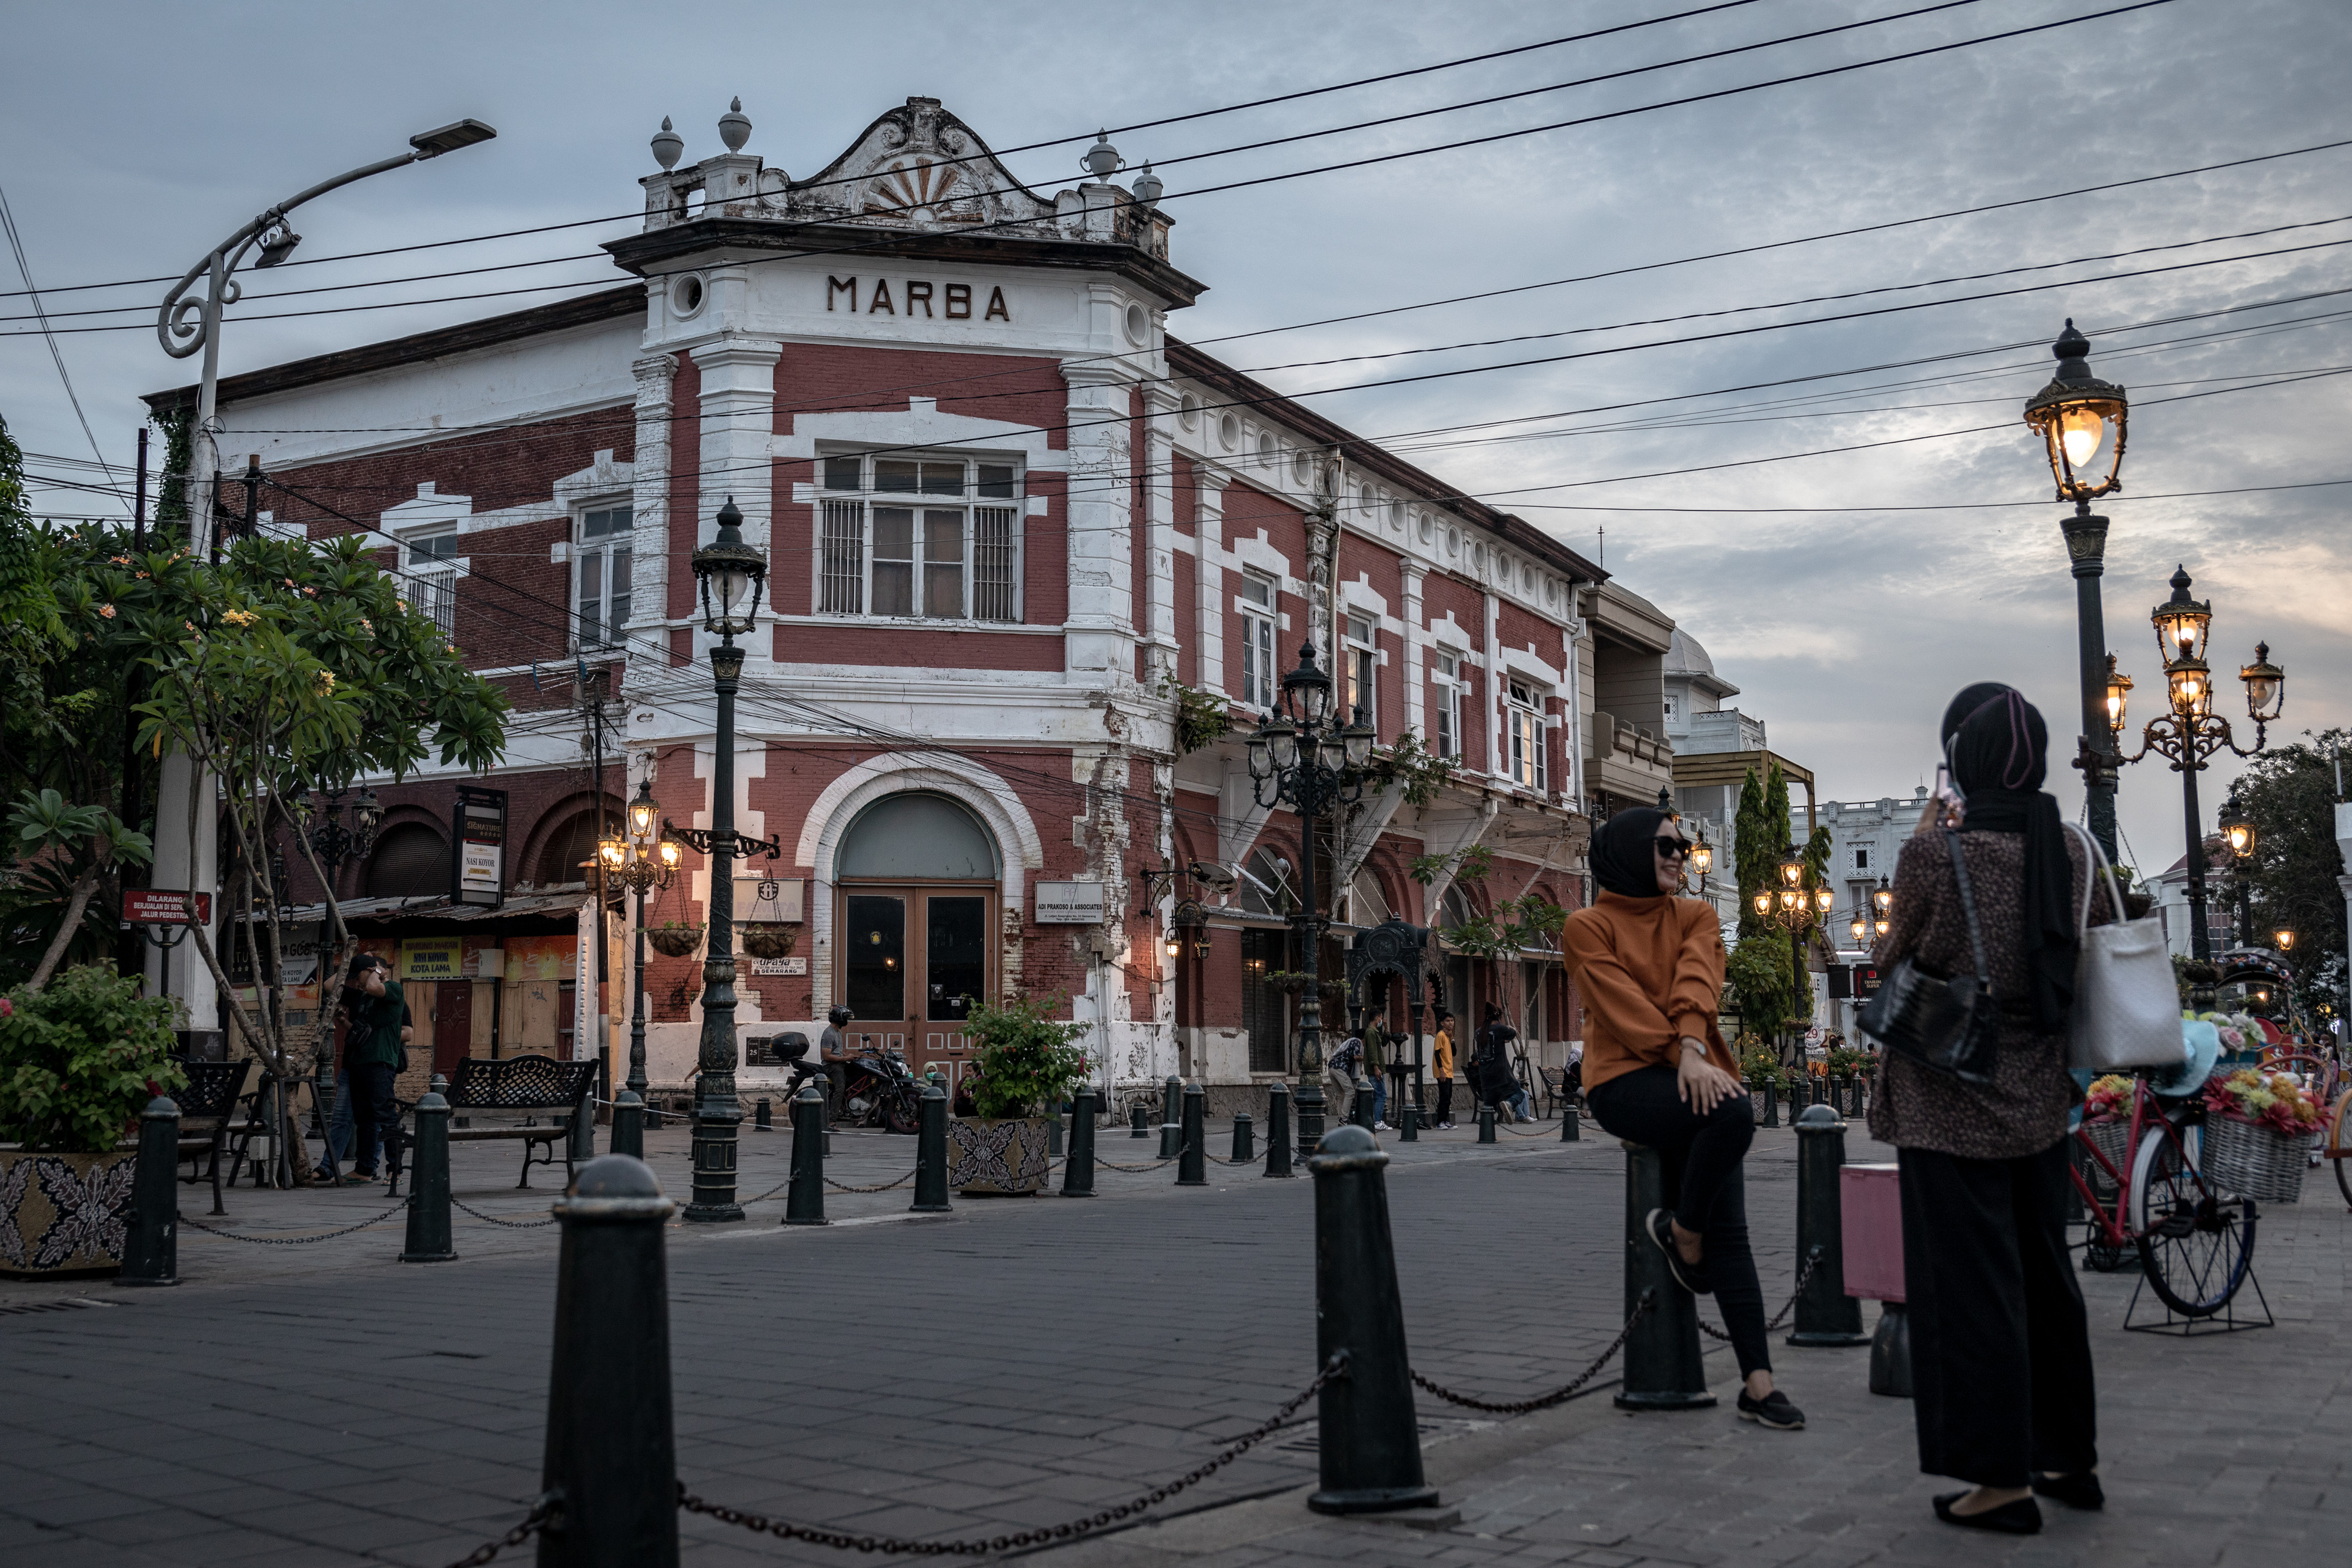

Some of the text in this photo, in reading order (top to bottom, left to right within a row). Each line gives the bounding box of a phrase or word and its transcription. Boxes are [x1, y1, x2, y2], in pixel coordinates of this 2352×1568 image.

[828, 275, 1010, 321] MARBA
[467, 823, 501, 832] SIGNATURE
[466, 857, 495, 867] NASI KOYOR
[413, 952, 449, 962] NASI KOYOR
[410, 964, 451, 974] KOTA LAMA
[1809, 979, 1820, 991] ULE
[1813, 1022, 1823, 1032] GULE
[1806, 1028, 1818, 1039] 29
